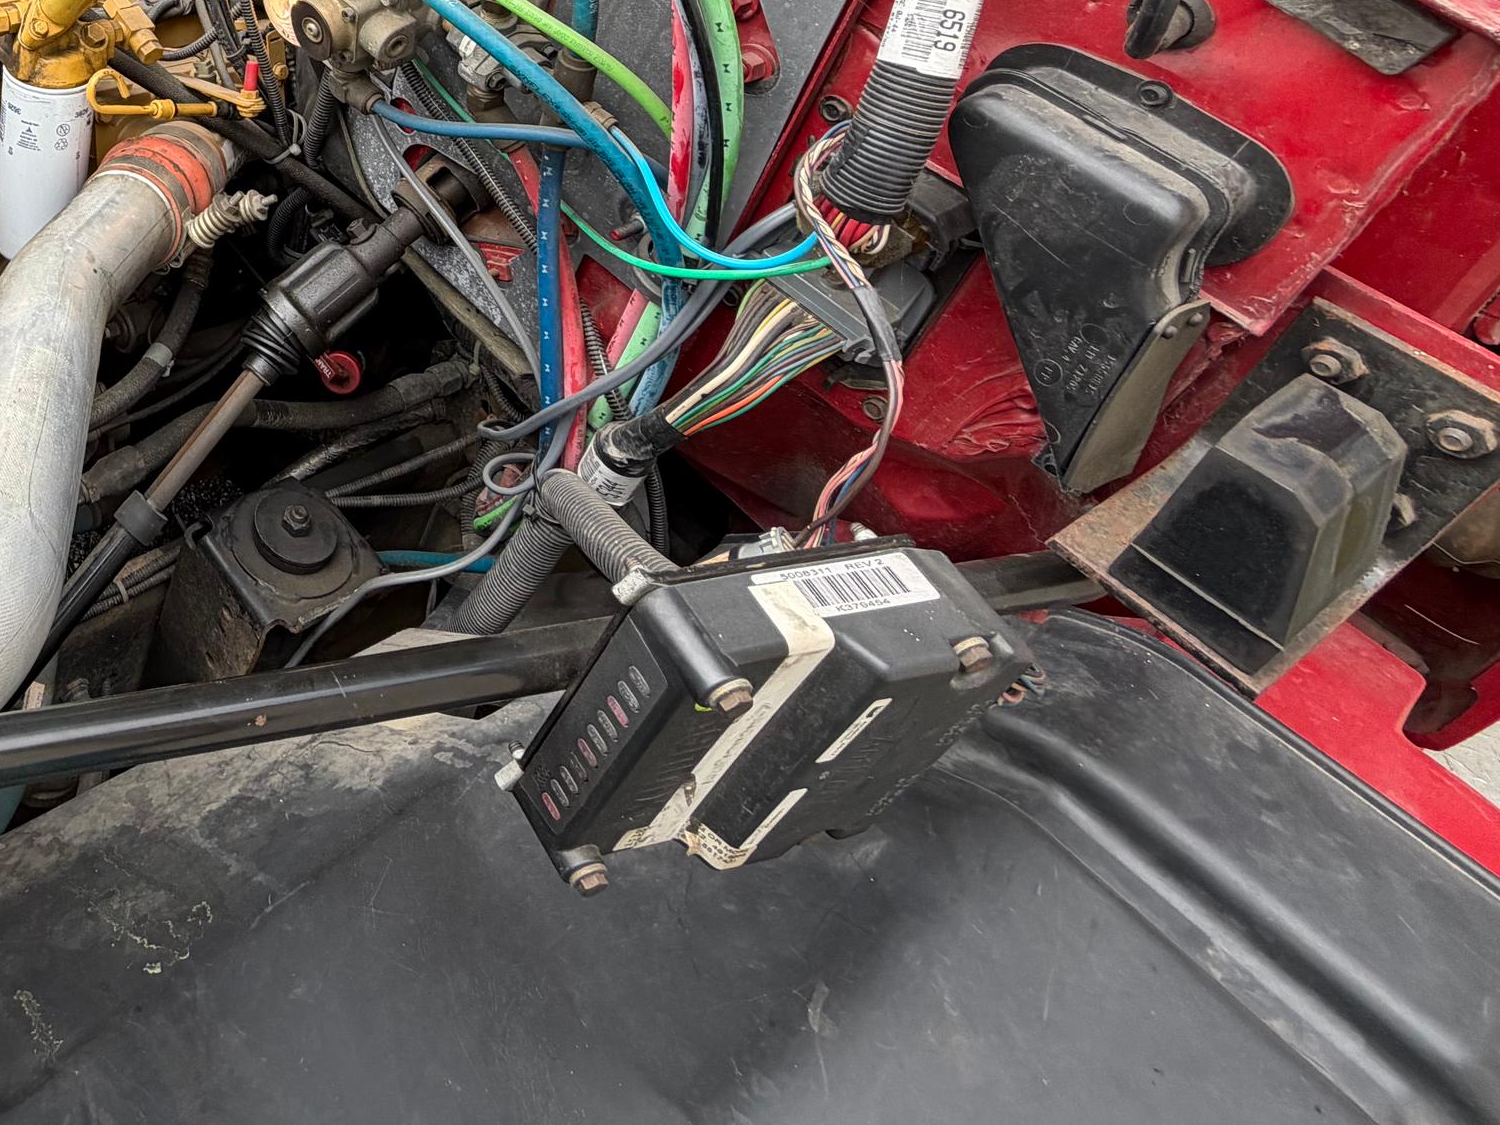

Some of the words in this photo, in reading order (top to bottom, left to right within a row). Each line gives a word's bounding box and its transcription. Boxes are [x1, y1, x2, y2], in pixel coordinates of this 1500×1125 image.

[934, 9, 966, 52] 6519
[780, 566, 832, 581] 5008311
[844, 560, 872, 571] REV
[874, 558, 884, 566] 2
